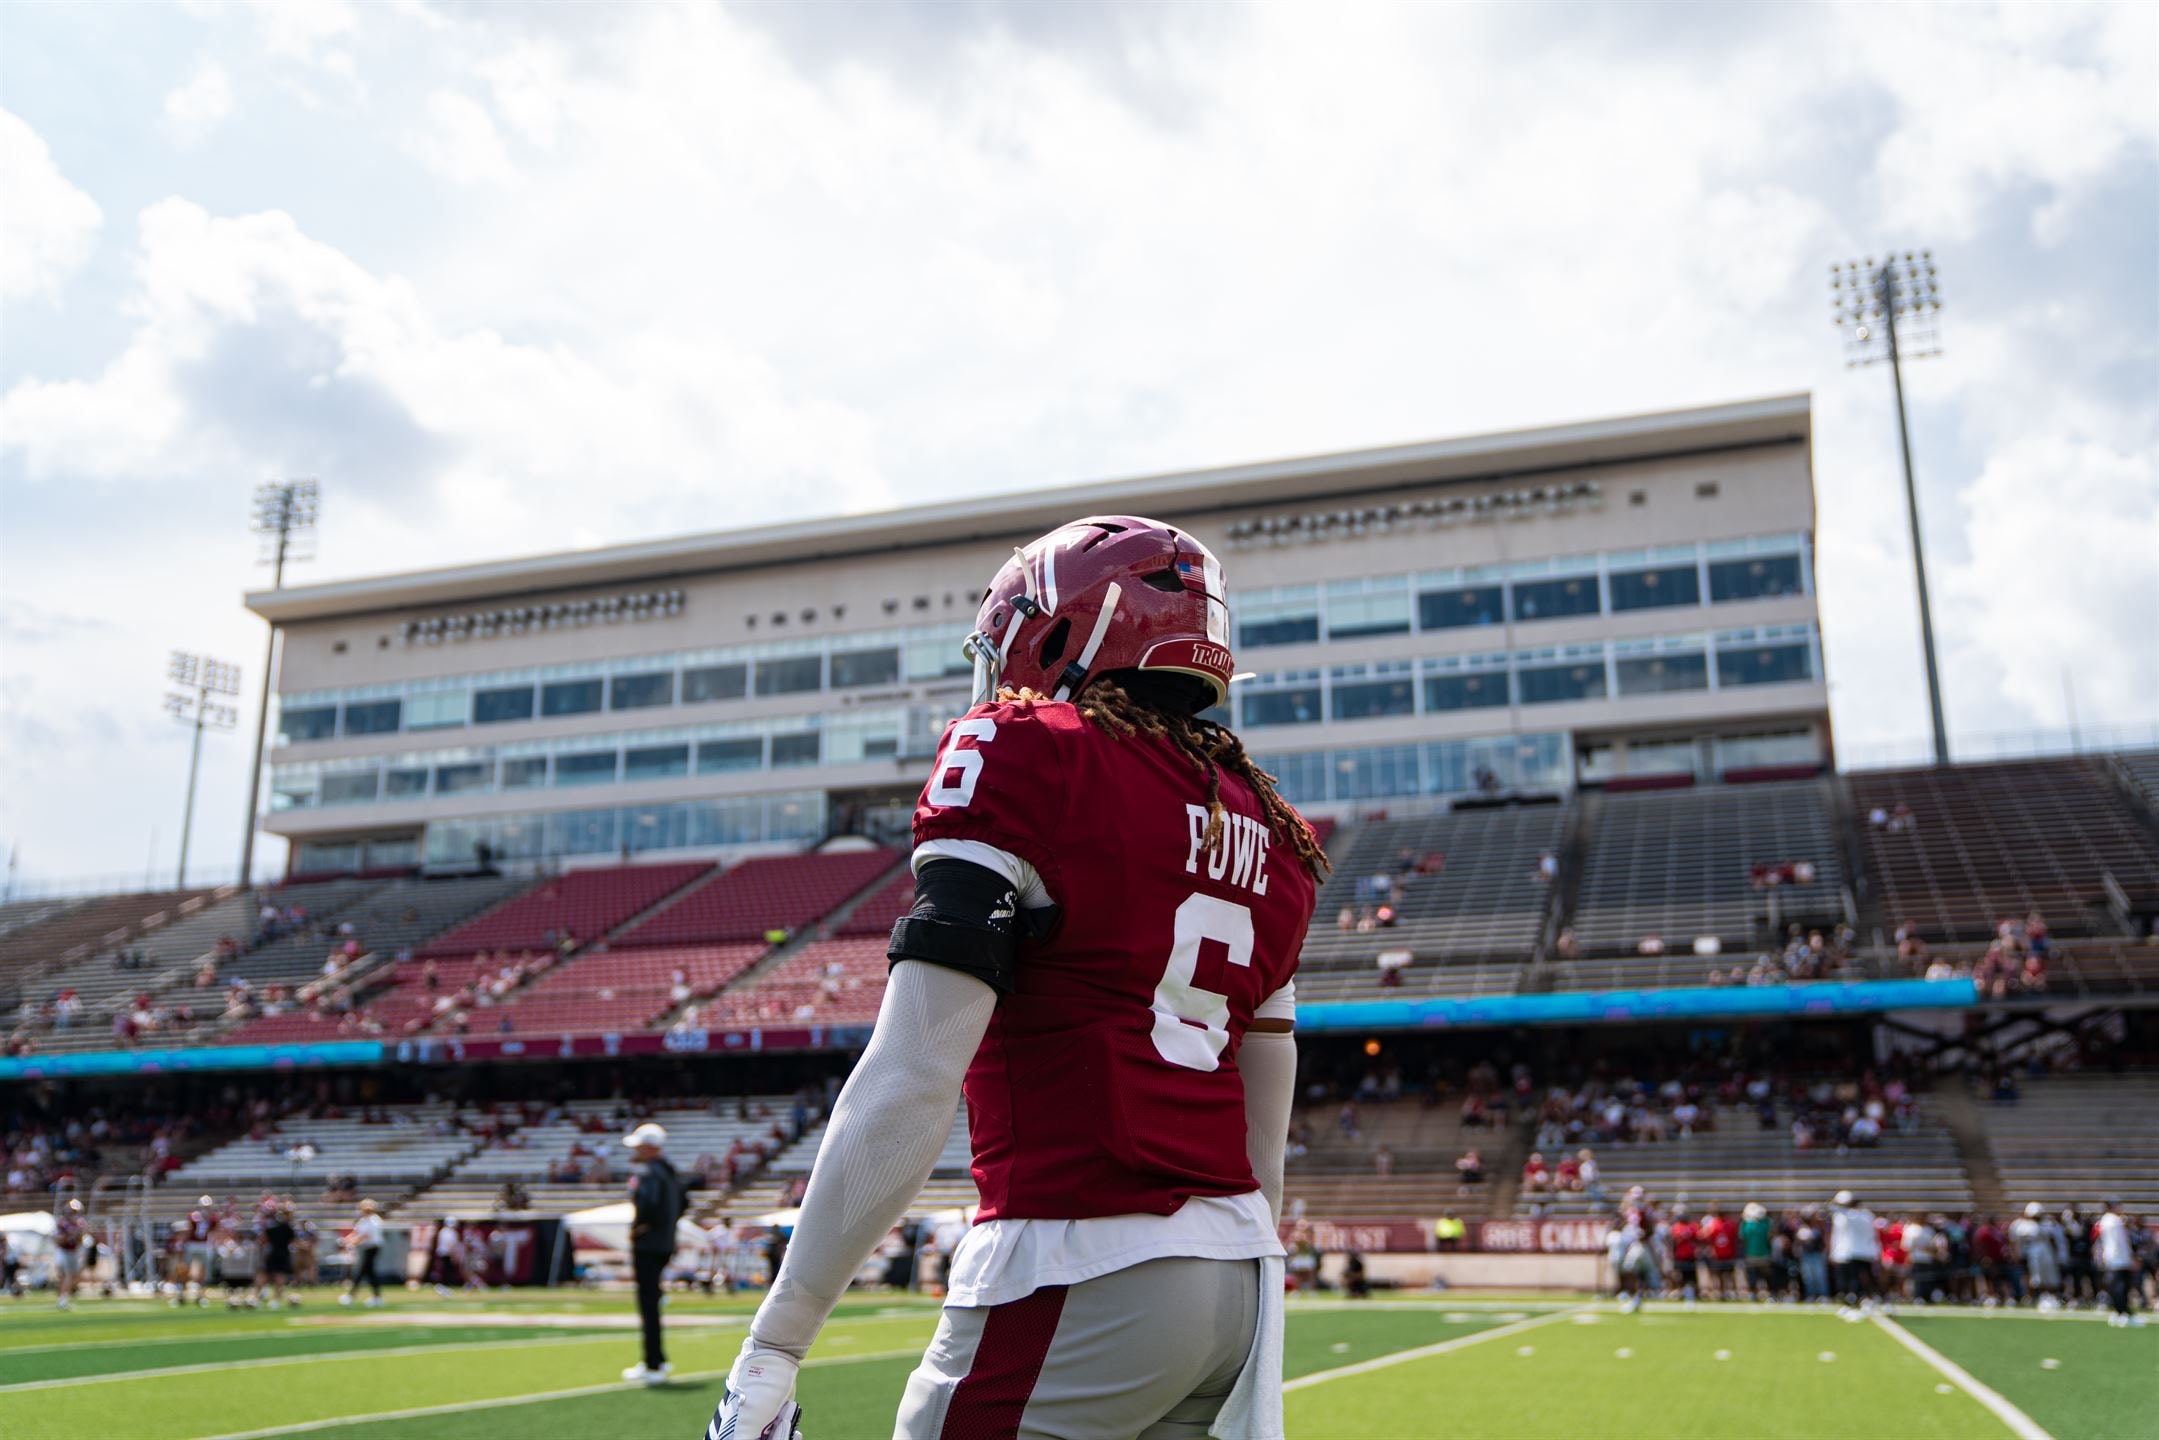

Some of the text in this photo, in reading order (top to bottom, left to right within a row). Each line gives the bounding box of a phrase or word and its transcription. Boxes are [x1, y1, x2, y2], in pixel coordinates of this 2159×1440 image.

[1192, 643, 1233, 680] TROJA
[927, 718, 997, 807] 6
[1186, 803, 1270, 896] POWE
[1149, 892, 1254, 1072] 6
